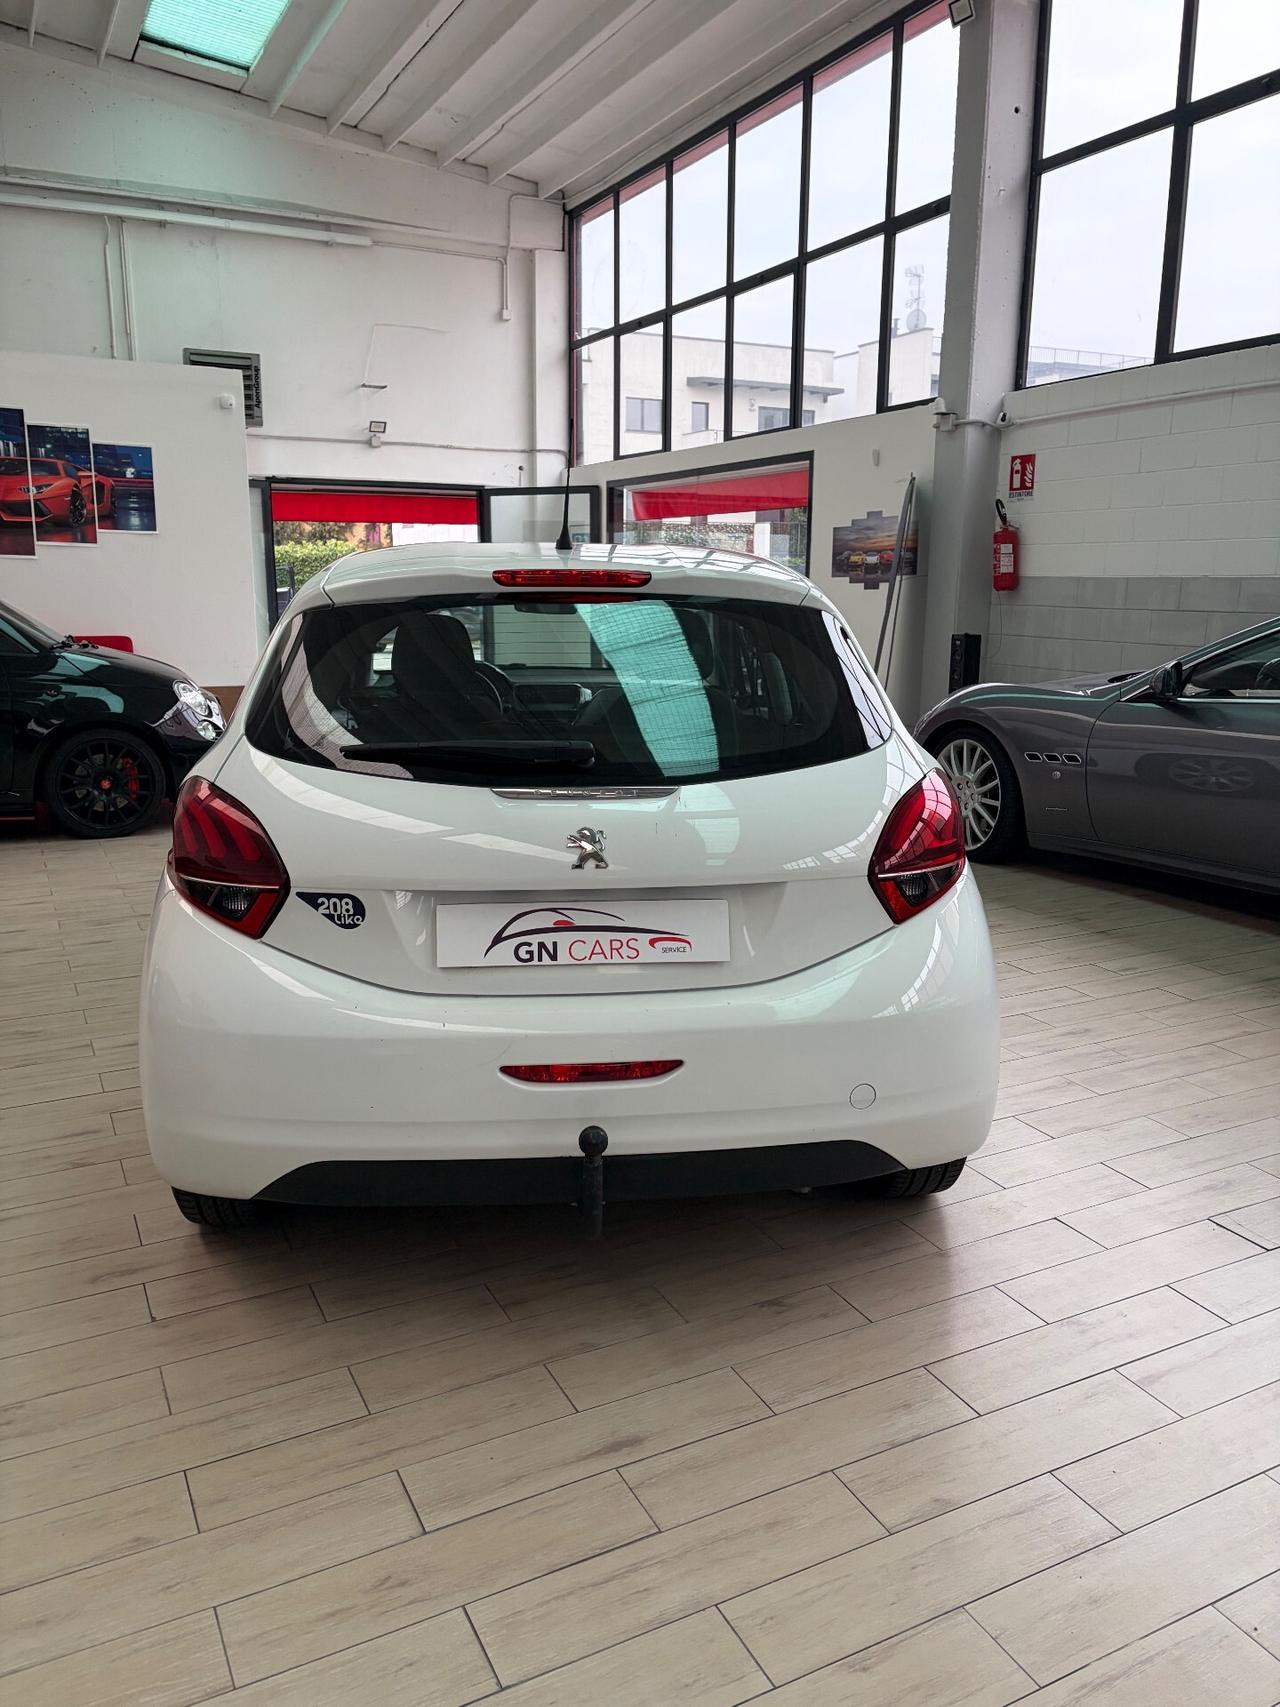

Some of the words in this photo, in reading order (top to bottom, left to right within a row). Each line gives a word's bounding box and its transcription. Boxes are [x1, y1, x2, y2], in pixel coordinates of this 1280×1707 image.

[253, 366, 261, 408] ApenGroup
[317, 897, 354, 914] 208
[513, 941, 558, 963] GN
[568, 938, 640, 961] CARS
